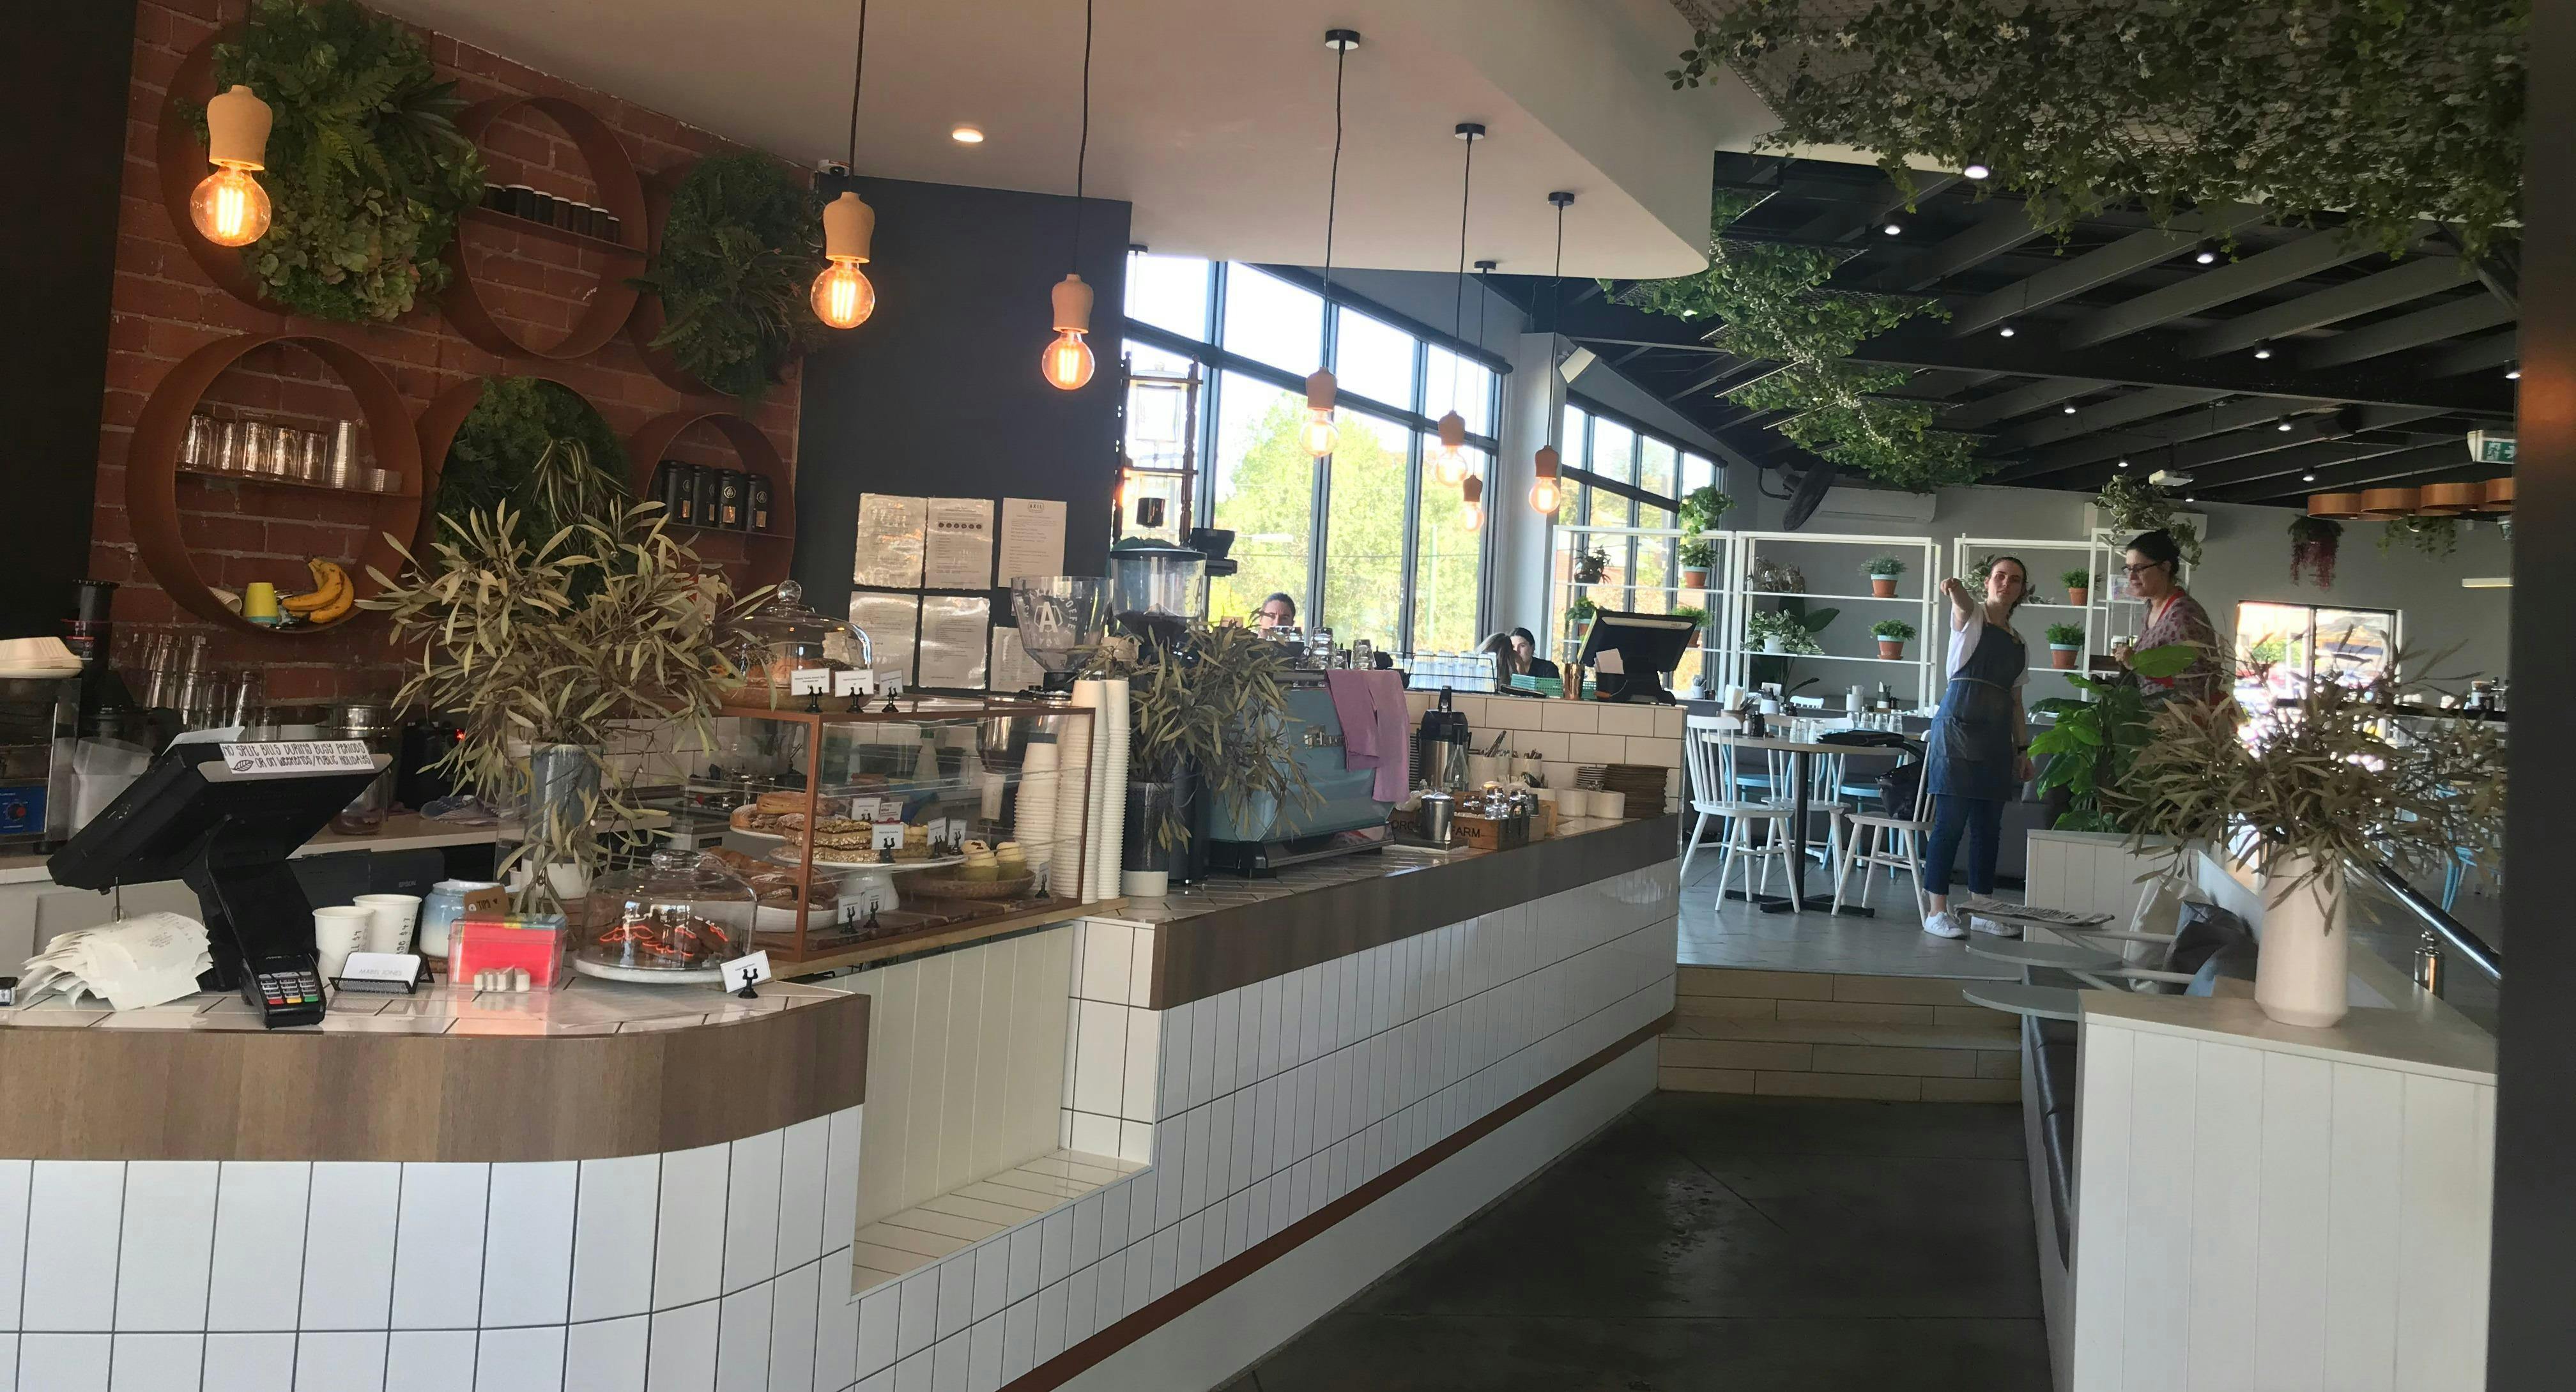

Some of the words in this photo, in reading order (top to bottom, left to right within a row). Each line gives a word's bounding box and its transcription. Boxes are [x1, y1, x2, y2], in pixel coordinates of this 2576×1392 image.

[1039, 601, 1058, 632] A
[224, 745, 234, 757] NO
[261, 744, 282, 756] BILLS
[284, 743, 312, 755] DURING
[312, 742, 334, 754] BUSY
[255, 758, 266, 768] OR
